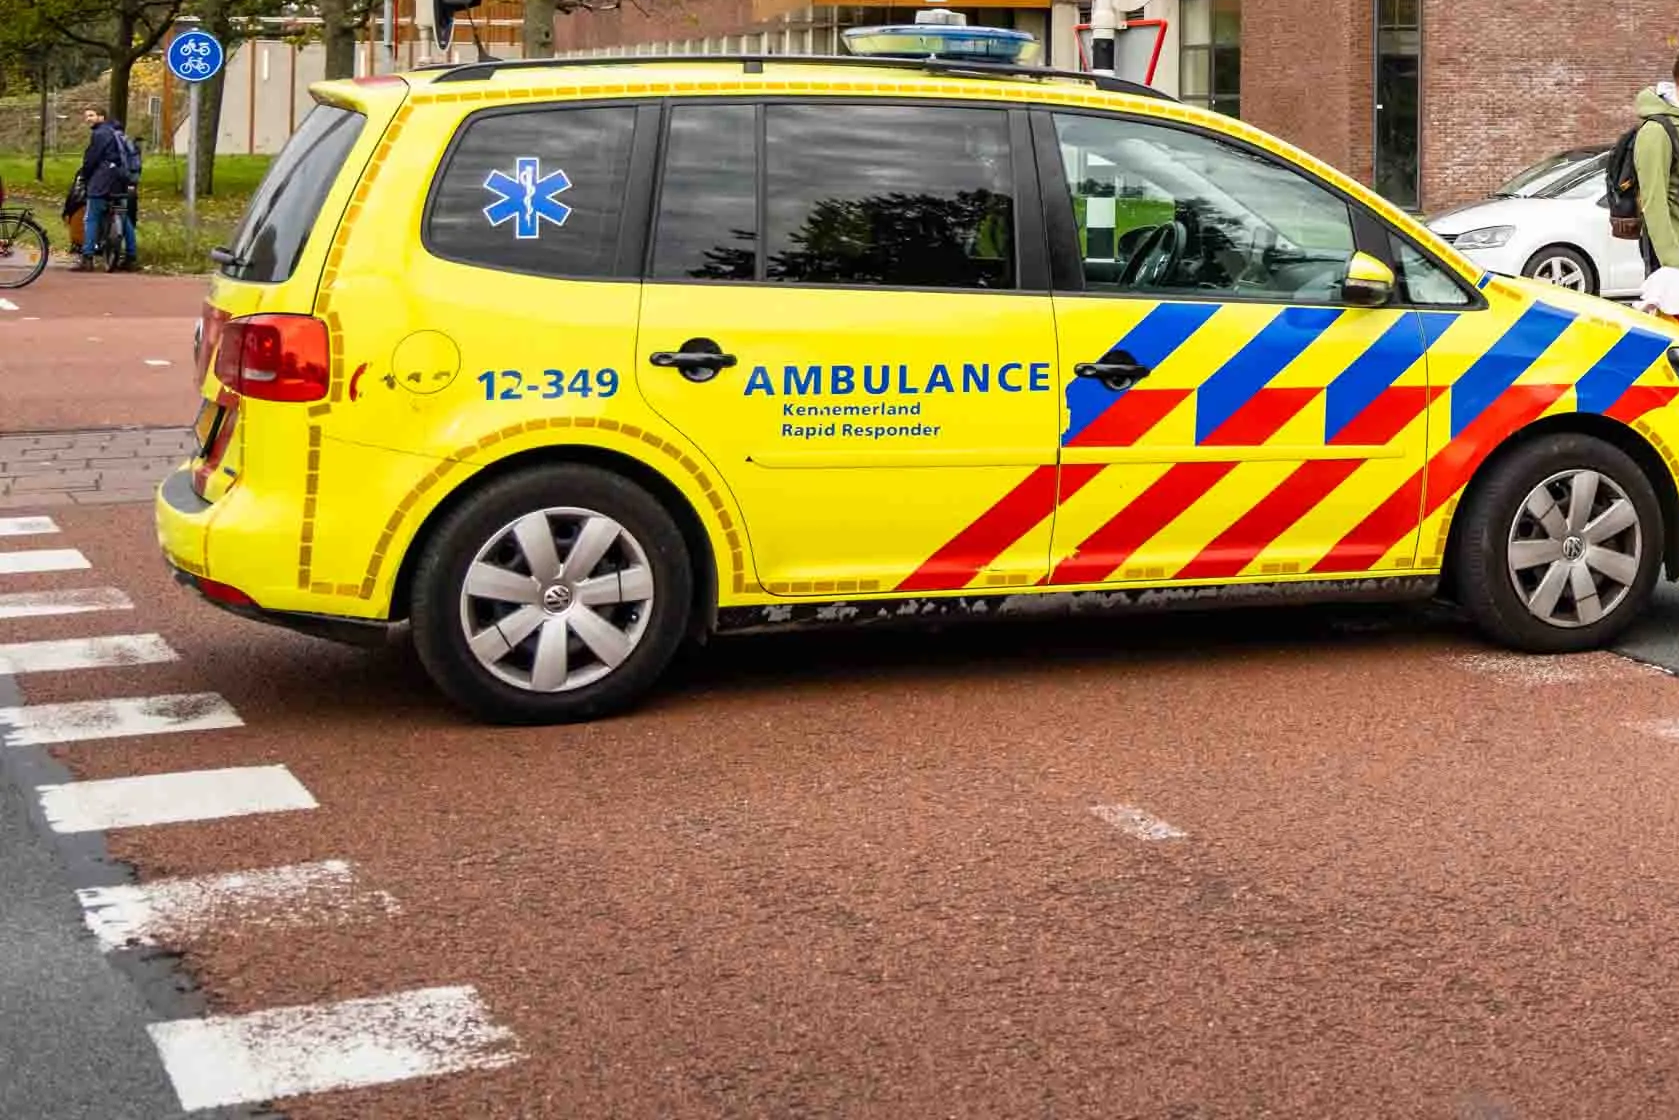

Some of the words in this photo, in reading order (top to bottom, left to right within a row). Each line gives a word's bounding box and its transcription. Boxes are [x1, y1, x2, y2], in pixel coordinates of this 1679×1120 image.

[477, 367, 620, 401] 12-349
[743, 362, 1050, 397] AMBULANCE
[783, 401, 921, 416] Kennemerland
[781, 423, 835, 440] Rapid
[842, 423, 941, 440] Responder
